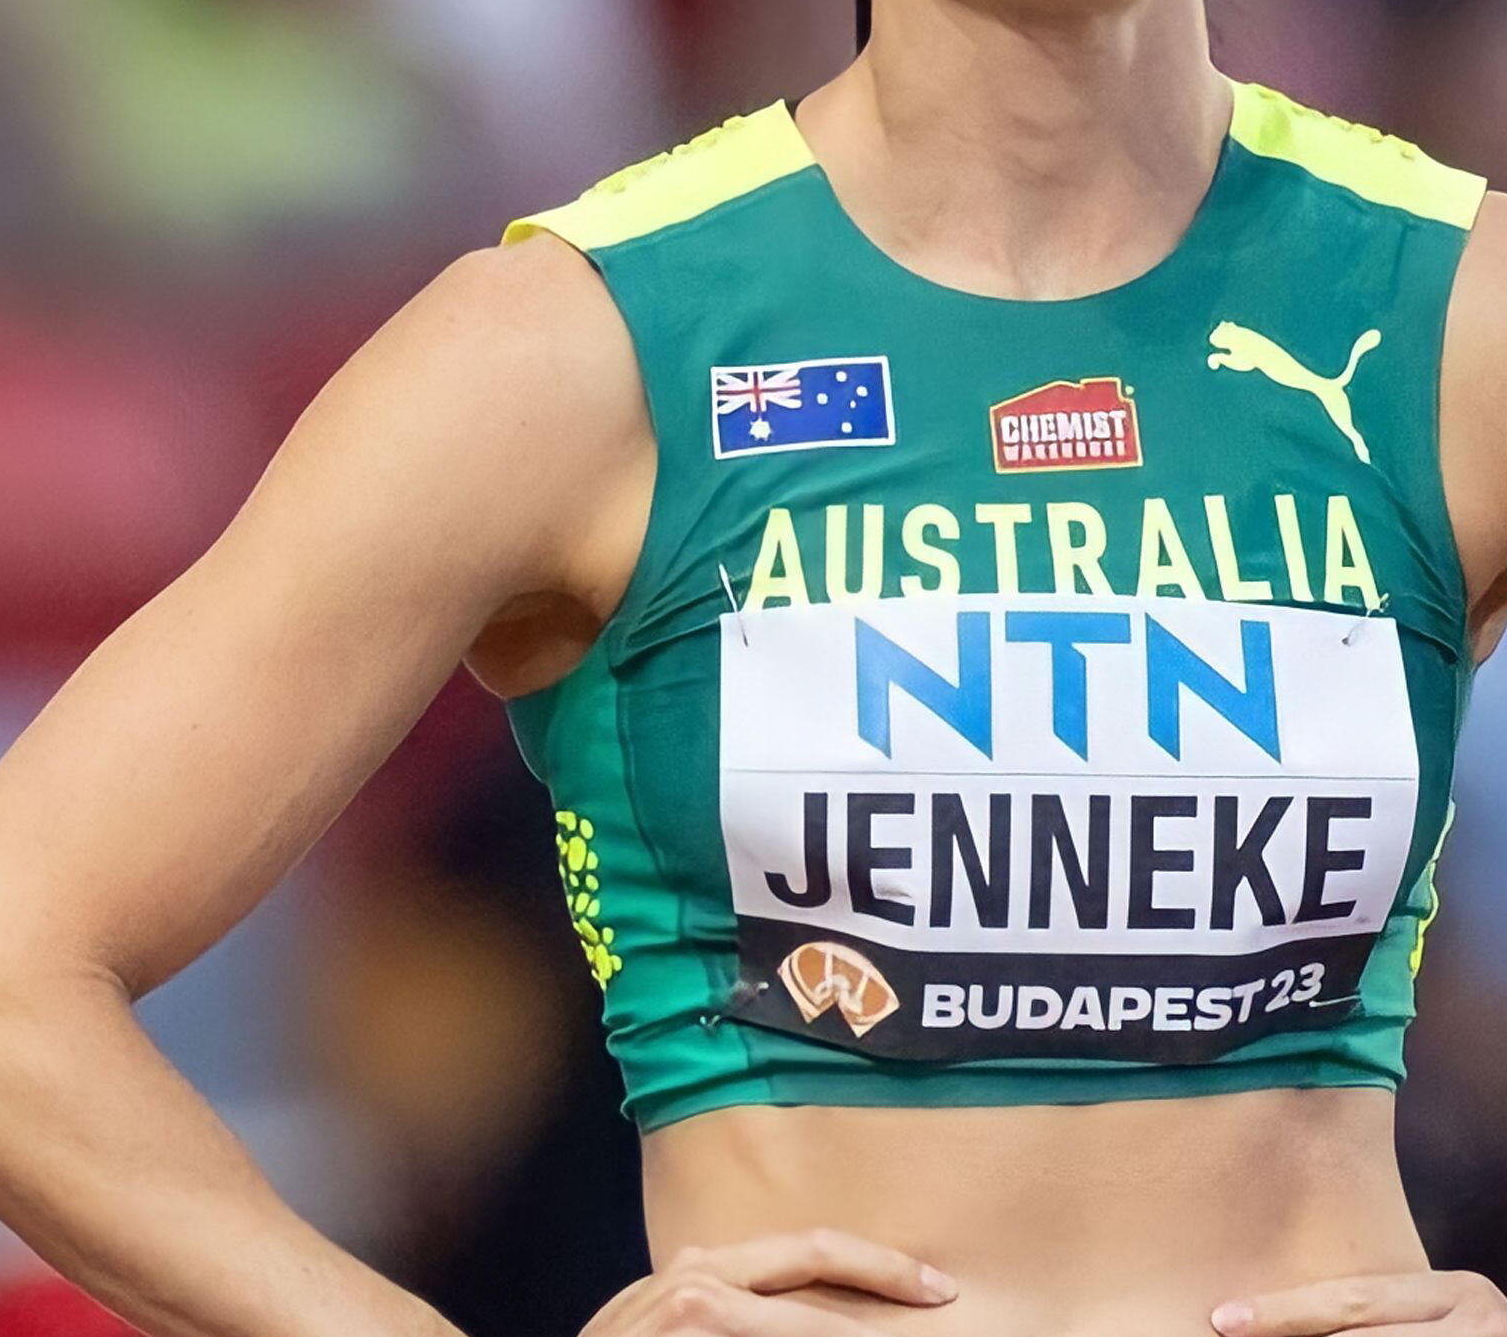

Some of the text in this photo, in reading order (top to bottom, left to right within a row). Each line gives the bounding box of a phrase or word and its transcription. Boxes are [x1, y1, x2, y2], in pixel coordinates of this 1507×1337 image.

[1000, 410, 1127, 444] CHEMIST
[747, 493, 1384, 611] AUSTRALIA
[854, 611, 1283, 765] NTN
[764, 792, 1375, 932] JENNEKE
[921, 979, 1265, 1031] BUDAPEST
